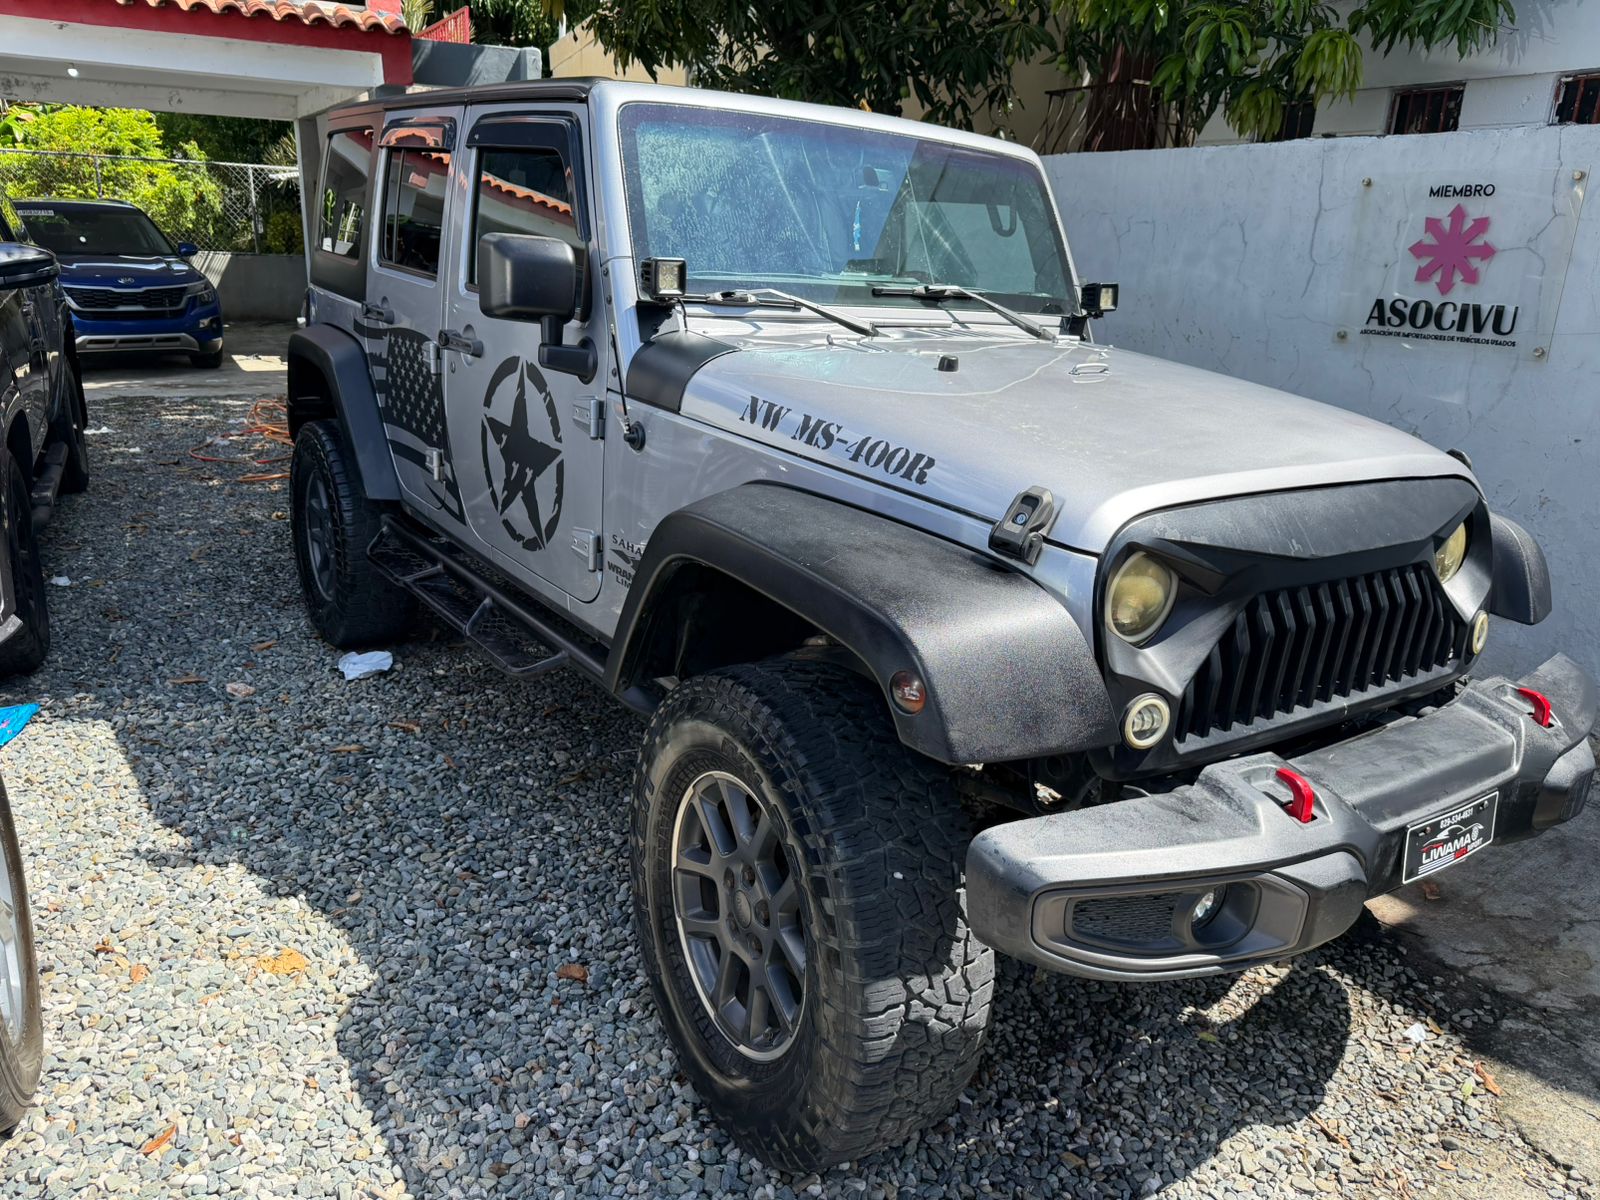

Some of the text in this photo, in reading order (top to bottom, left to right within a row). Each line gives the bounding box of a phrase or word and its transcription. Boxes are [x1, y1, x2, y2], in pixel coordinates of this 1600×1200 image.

[1429, 184, 1495, 198] MIEMBRO
[1365, 298, 1519, 336] ASOCIVU
[1402, 332, 1446, 342] IMPORTADORES
[1490, 339, 1516, 347] USADOS
[739, 395, 936, 485] NW MS-400R
